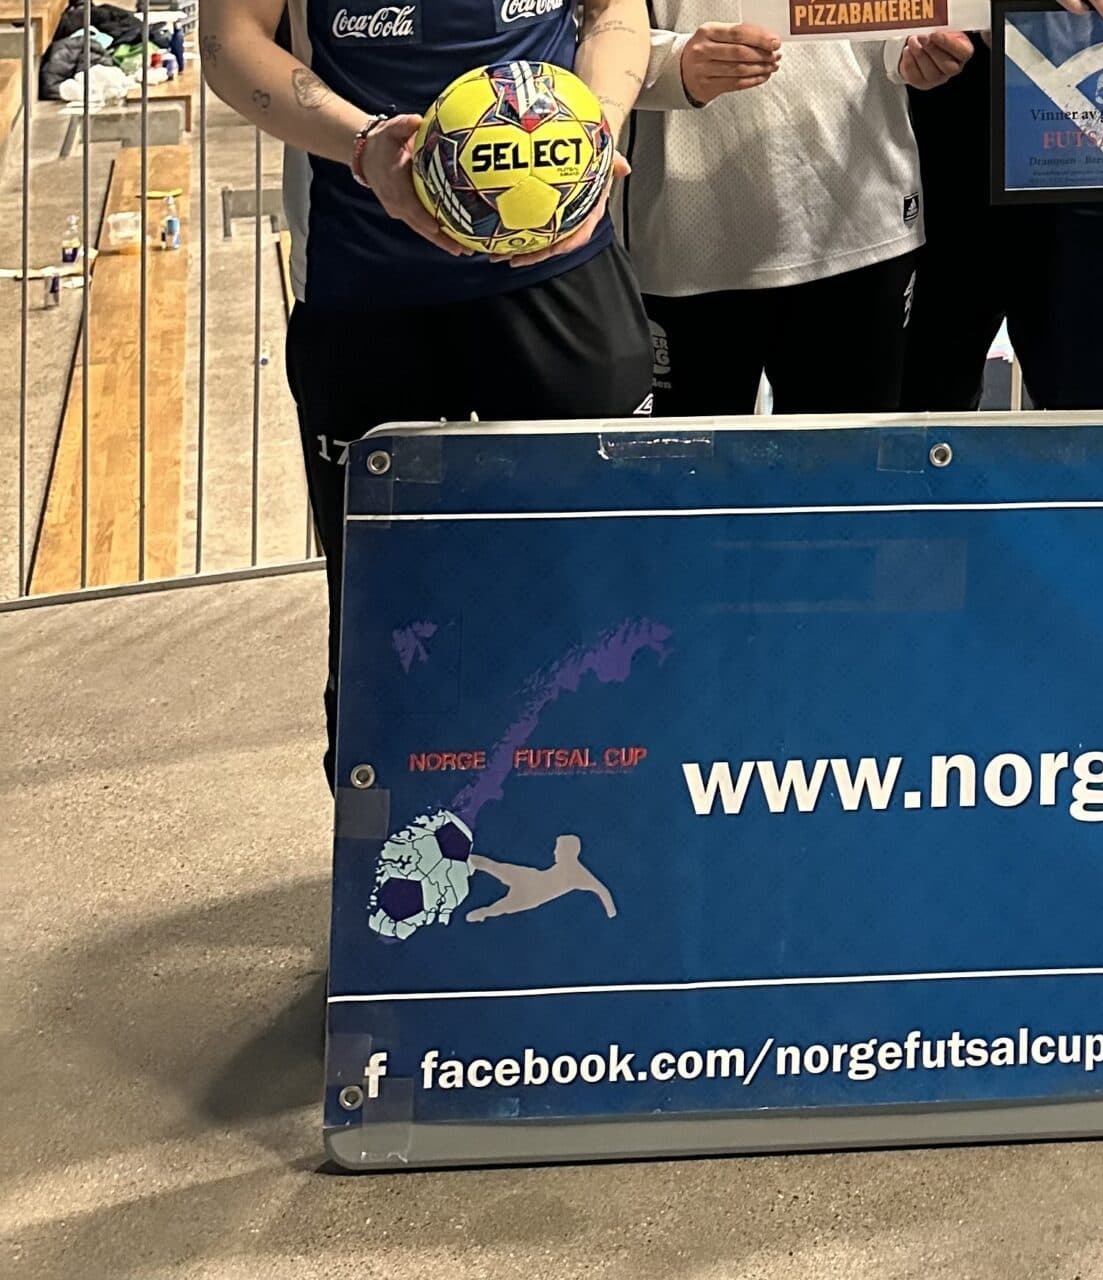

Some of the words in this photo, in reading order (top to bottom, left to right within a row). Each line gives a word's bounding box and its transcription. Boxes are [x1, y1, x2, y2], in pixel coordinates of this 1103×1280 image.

[332, 5, 414, 39] Coca-Cola
[1031, 108, 1079, 121] Vinner
[1081, 109, 1097, 120] av
[471, 138, 582, 173] SELECT
[317, 434, 349, 465] 17
[409, 751, 486, 772] NORGE
[514, 748, 596, 769] FUTSAL
[603, 745, 648, 767] CUP
